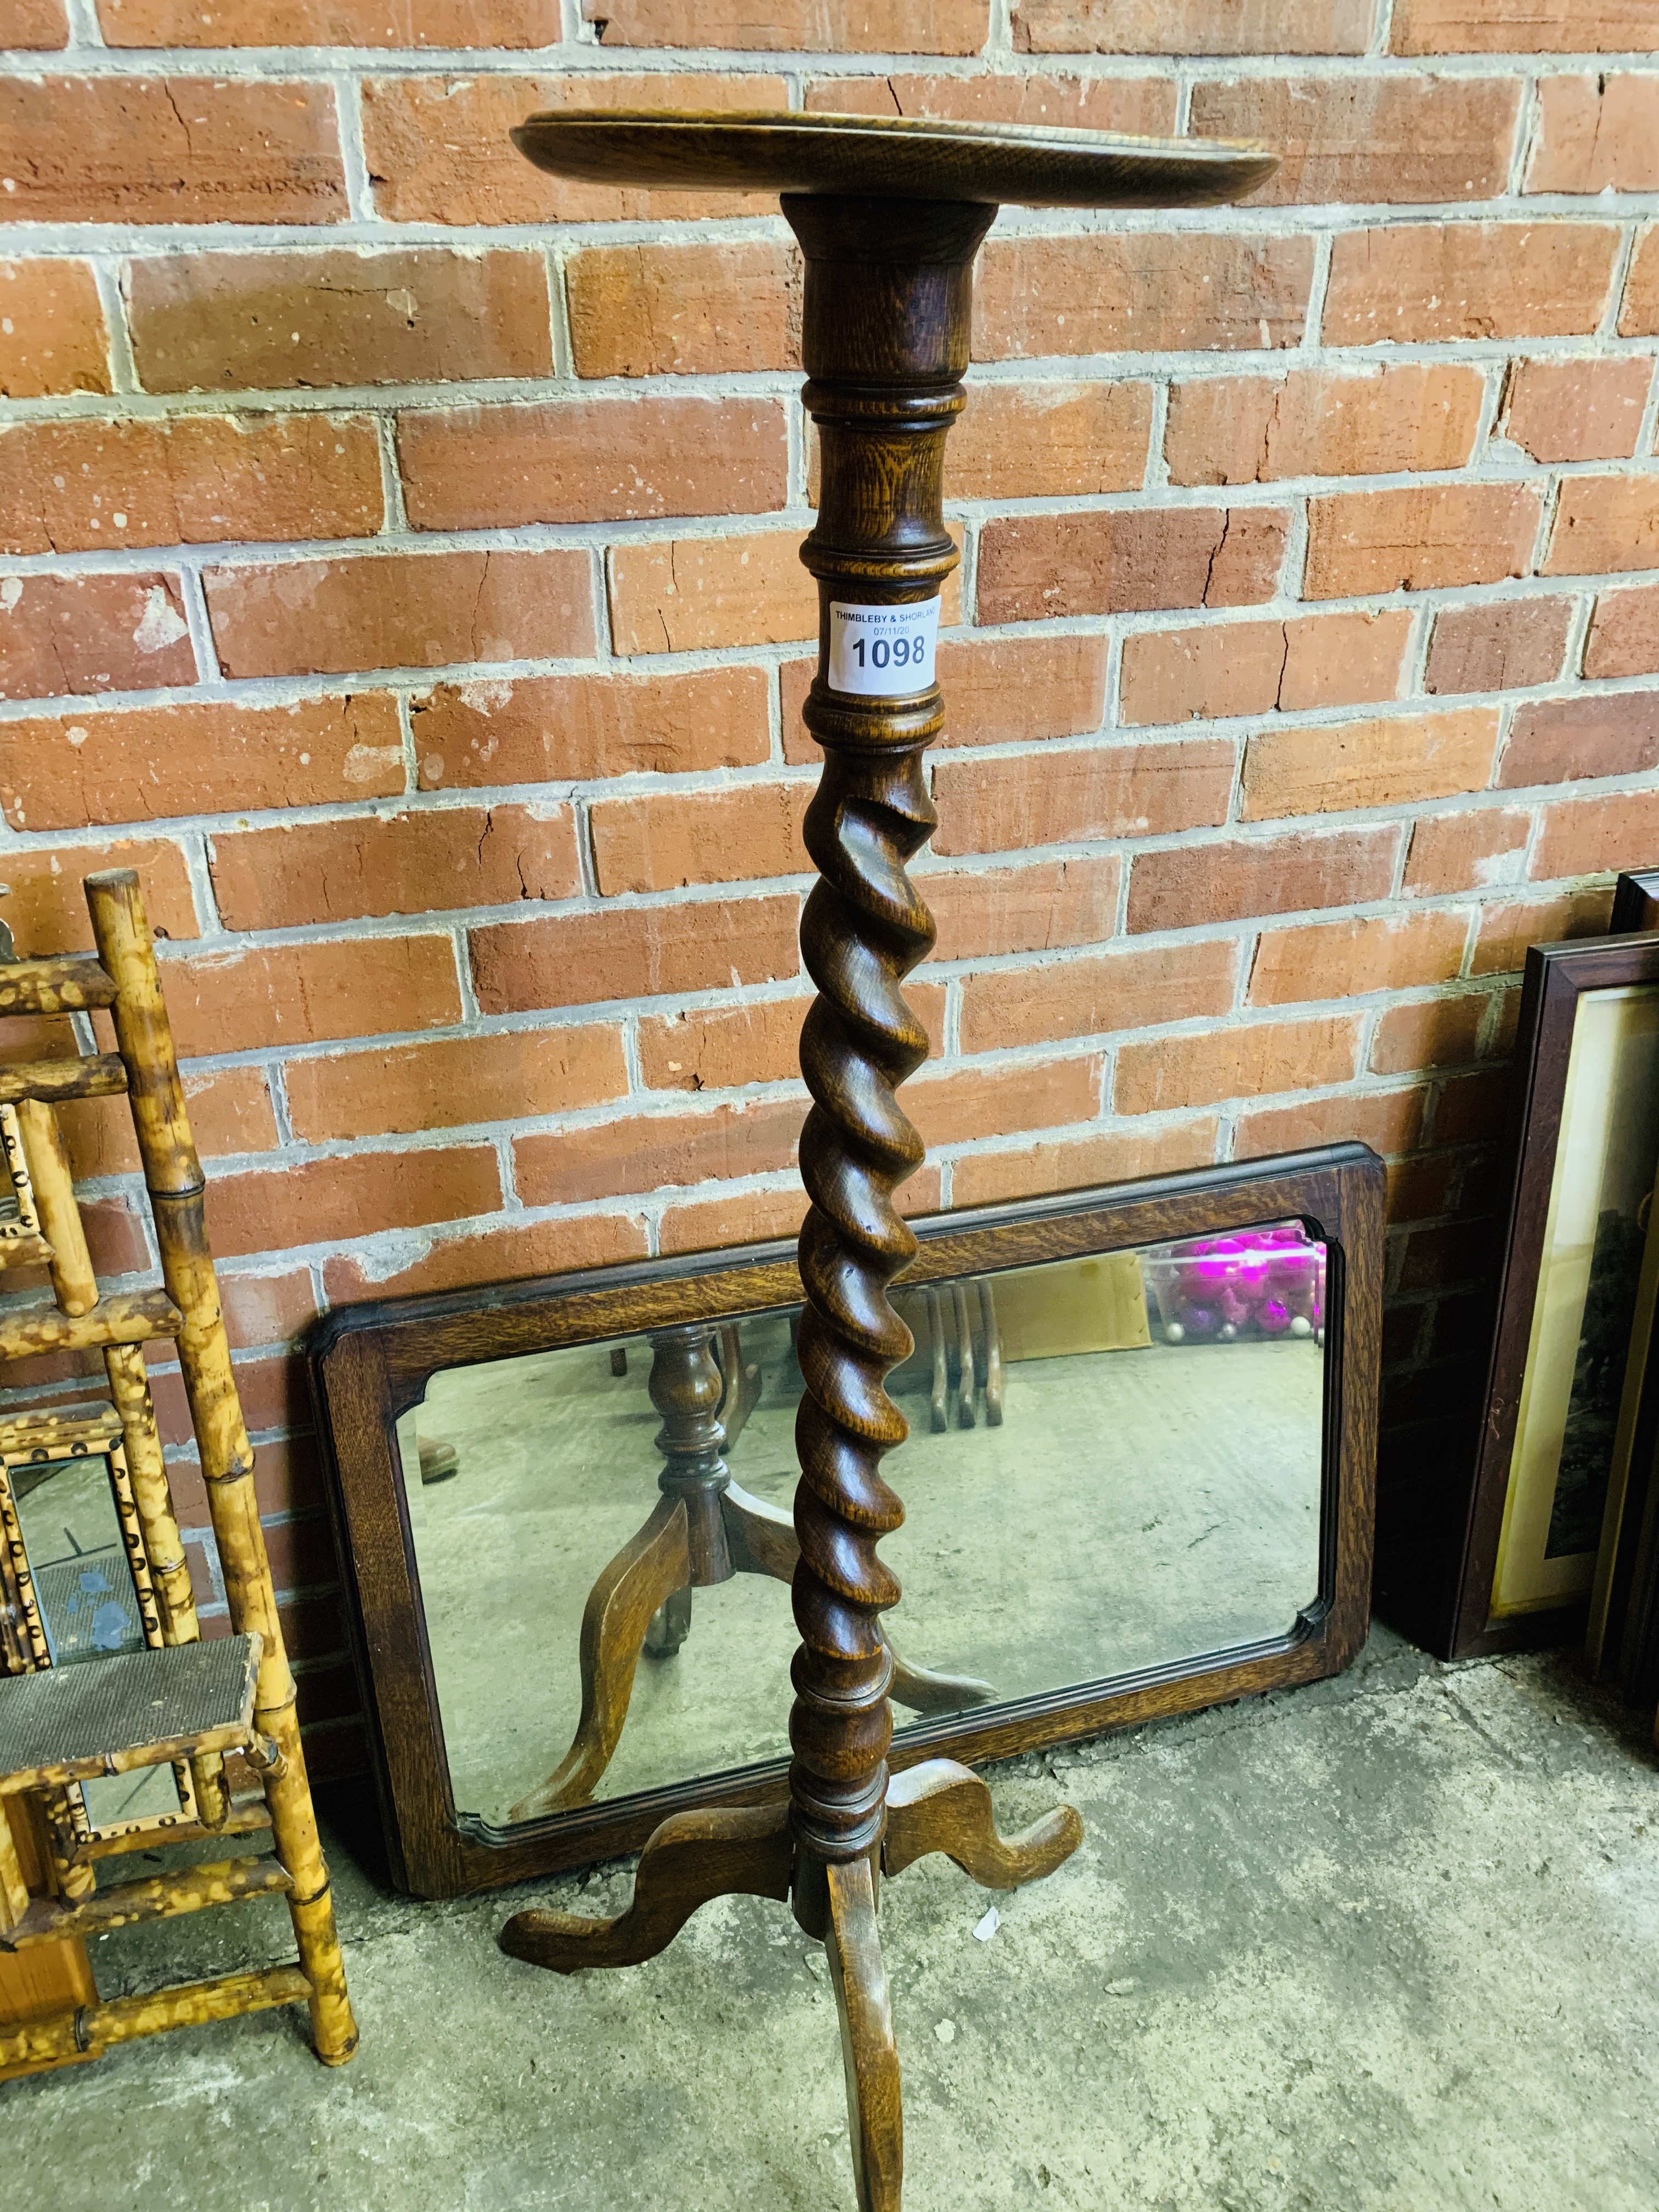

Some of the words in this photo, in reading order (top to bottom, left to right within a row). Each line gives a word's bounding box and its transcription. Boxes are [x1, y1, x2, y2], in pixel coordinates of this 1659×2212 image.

[836, 611, 887, 623] THIMBLEBY
[900, 607, 935, 622] SHORLAND
[874, 626, 910, 635] 07/11/20
[853, 635, 924, 668] 1098
